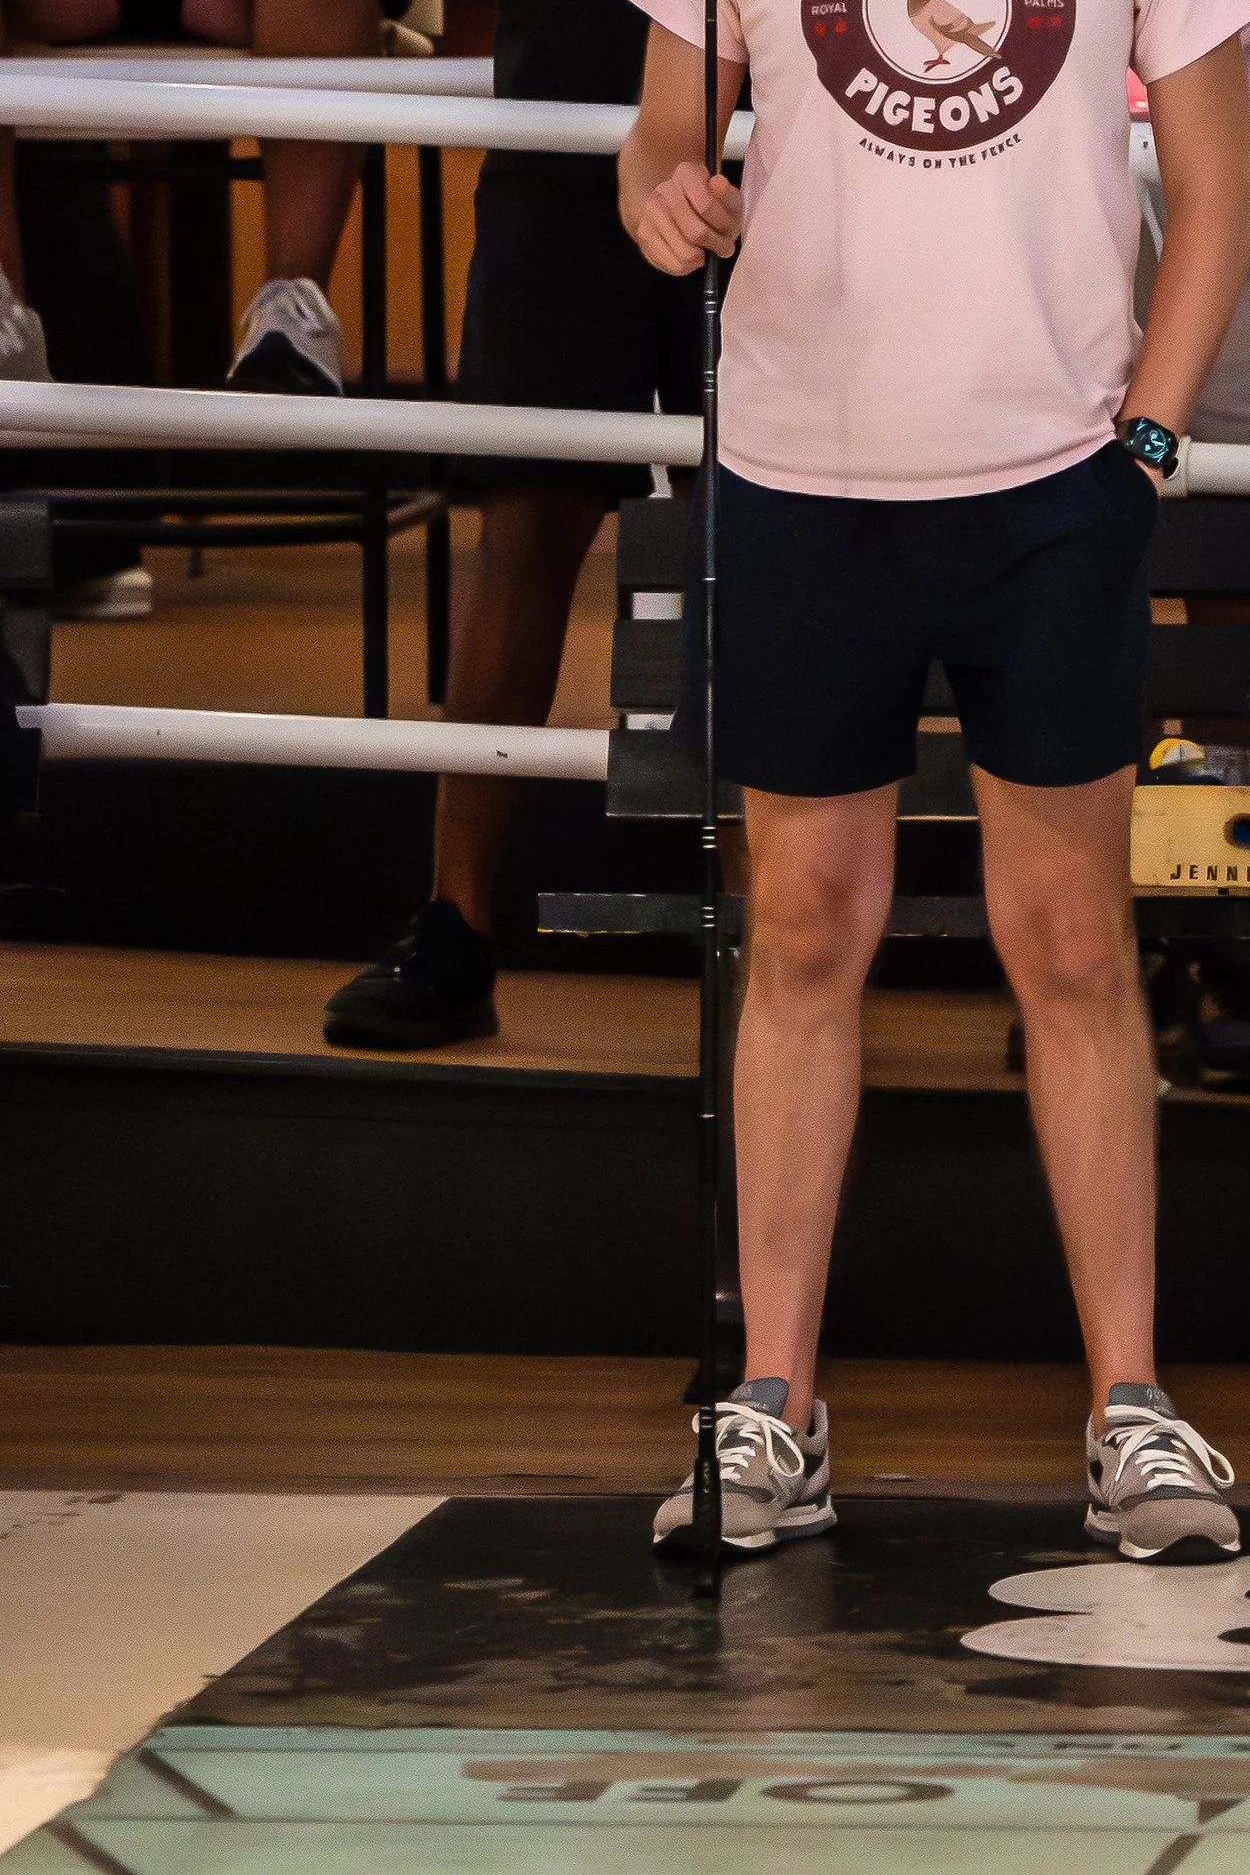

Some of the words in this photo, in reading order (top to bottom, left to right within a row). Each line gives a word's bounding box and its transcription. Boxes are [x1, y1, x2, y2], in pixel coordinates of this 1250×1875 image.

[811, 1, 847, 16] ROYAL
[844, 66, 1024, 134] PIGEONS
[859, 137, 916, 167] ALWAYS
[948, 155, 977, 169] THE
